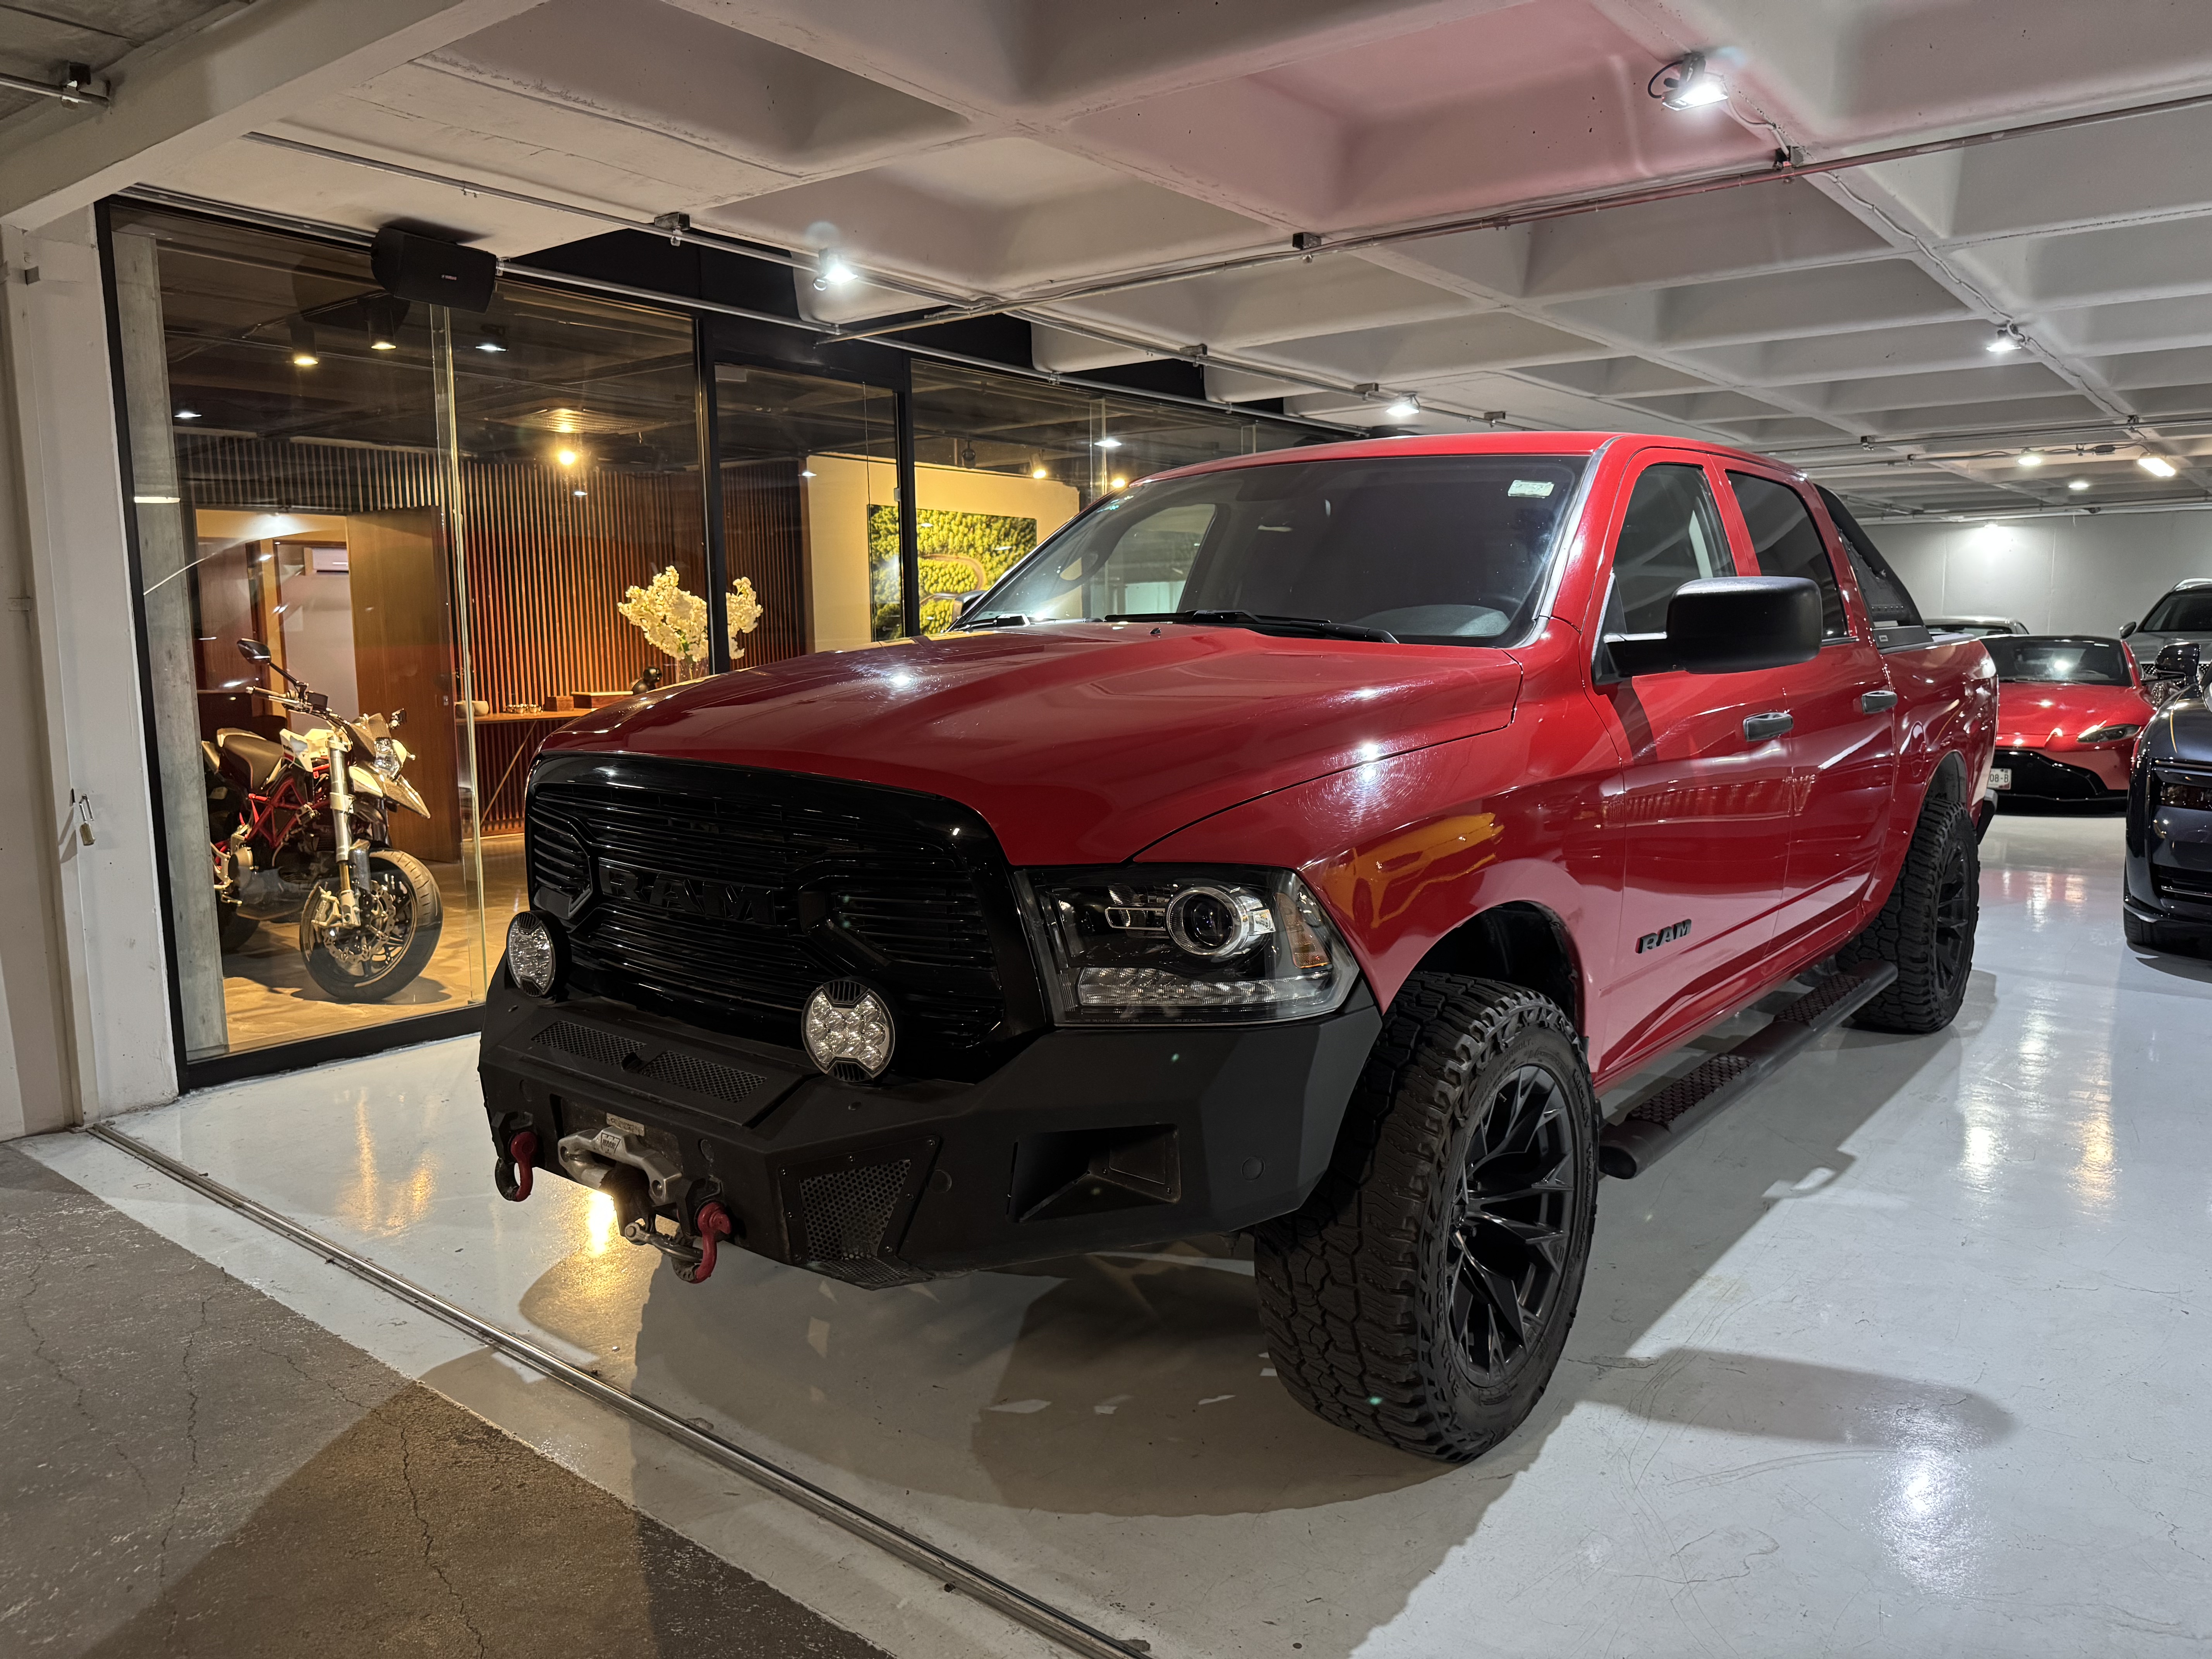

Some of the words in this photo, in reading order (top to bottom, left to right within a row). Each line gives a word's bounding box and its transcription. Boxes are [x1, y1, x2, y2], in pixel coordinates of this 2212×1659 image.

[598, 859, 776, 925] RAM
[1637, 919, 1692, 954] RAM
[602, 1139, 616, 1149] WARN
